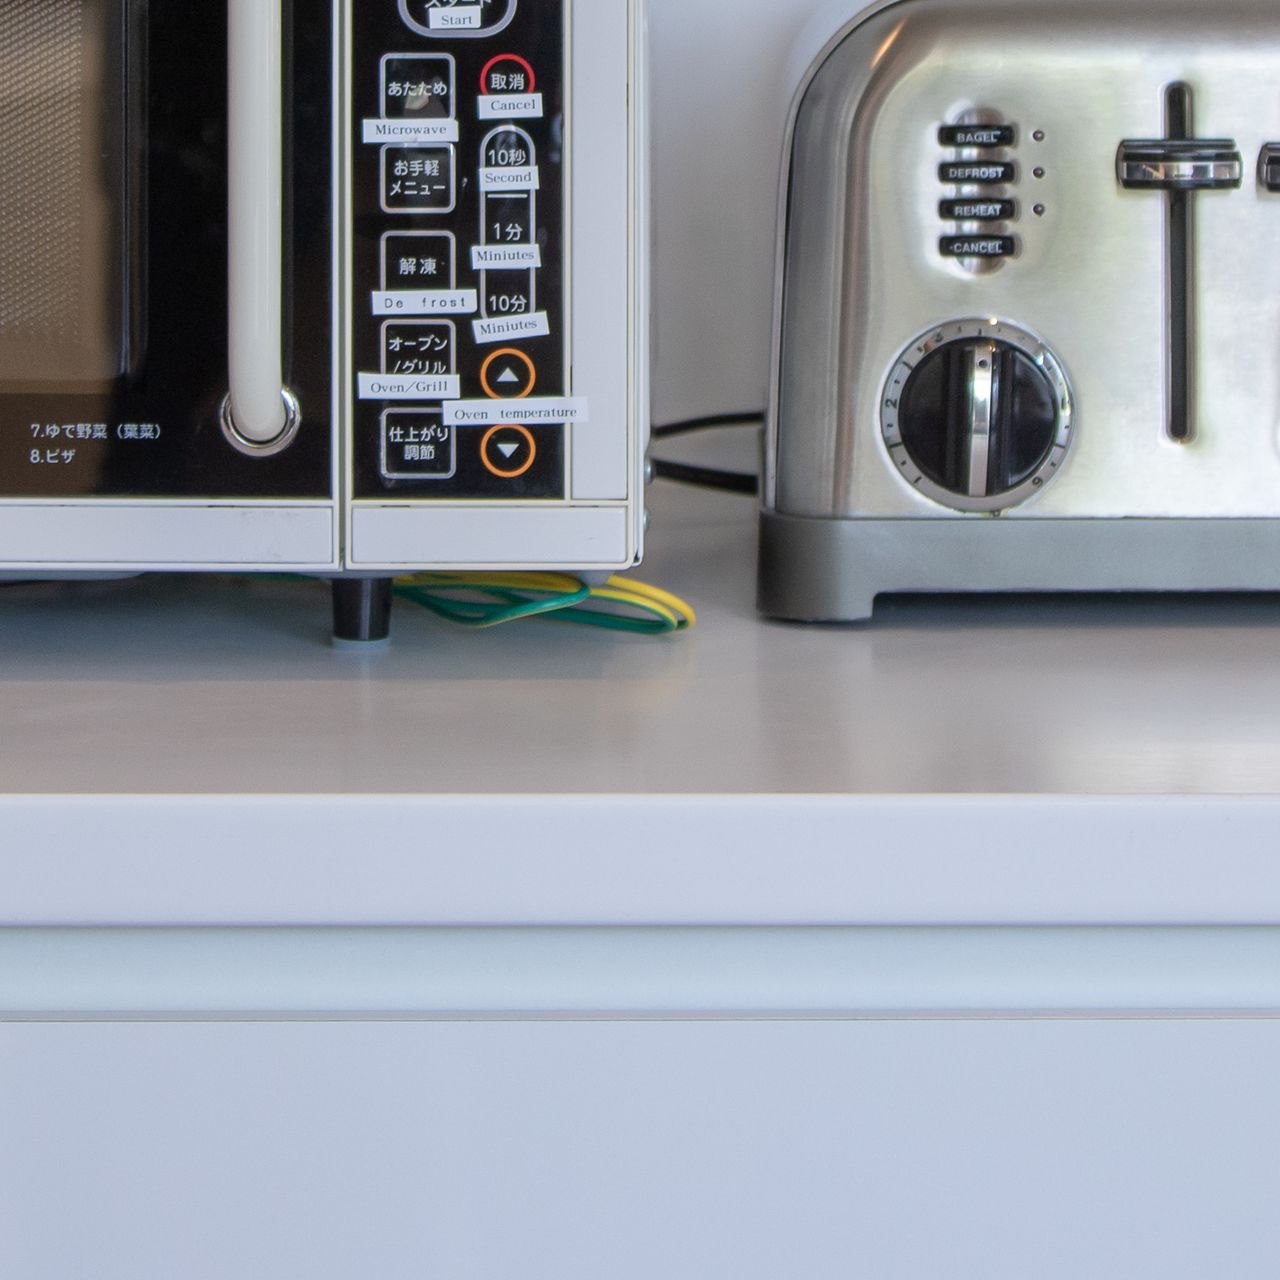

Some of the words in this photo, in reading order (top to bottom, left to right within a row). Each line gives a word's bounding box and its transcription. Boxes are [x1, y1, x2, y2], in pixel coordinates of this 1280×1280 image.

[440, 13, 473, 26] Start
[387, 80, 448, 97] あたため
[490, 73, 525, 91] 取消
[490, 98, 536, 111] Cancel
[375, 123, 447, 136] Microwave
[956, 131, 1001, 143] BAGEL
[488, 148, 527, 166] 10秒
[393, 159, 440, 177] お手軽
[948, 166, 1005, 179] DEFROST
[484, 171, 532, 184] Second
[389, 182, 446, 197] メニュー
[953, 203, 1002, 217] REHEAT
[493, 222, 524, 241] 1分
[953, 240, 1003, 254] CANCEL
[476, 249, 535, 263] Miniutes
[399, 257, 438, 276] 解凍
[384, 297, 404, 309] De
[421, 296, 466, 309] frost
[488, 294, 528, 313] 10分
[479, 319, 538, 336] Miniutes
[388, 334, 448, 352] オープン
[393, 360, 447, 375] /グリル
[370, 380, 449, 394] Oven/Grill
[884, 398, 898, 409] 2
[454, 408, 489, 421] Oven
[499, 406, 578, 421] temperature
[388, 424, 449, 443] 仕上がり
[403, 443, 435, 461] 調節
